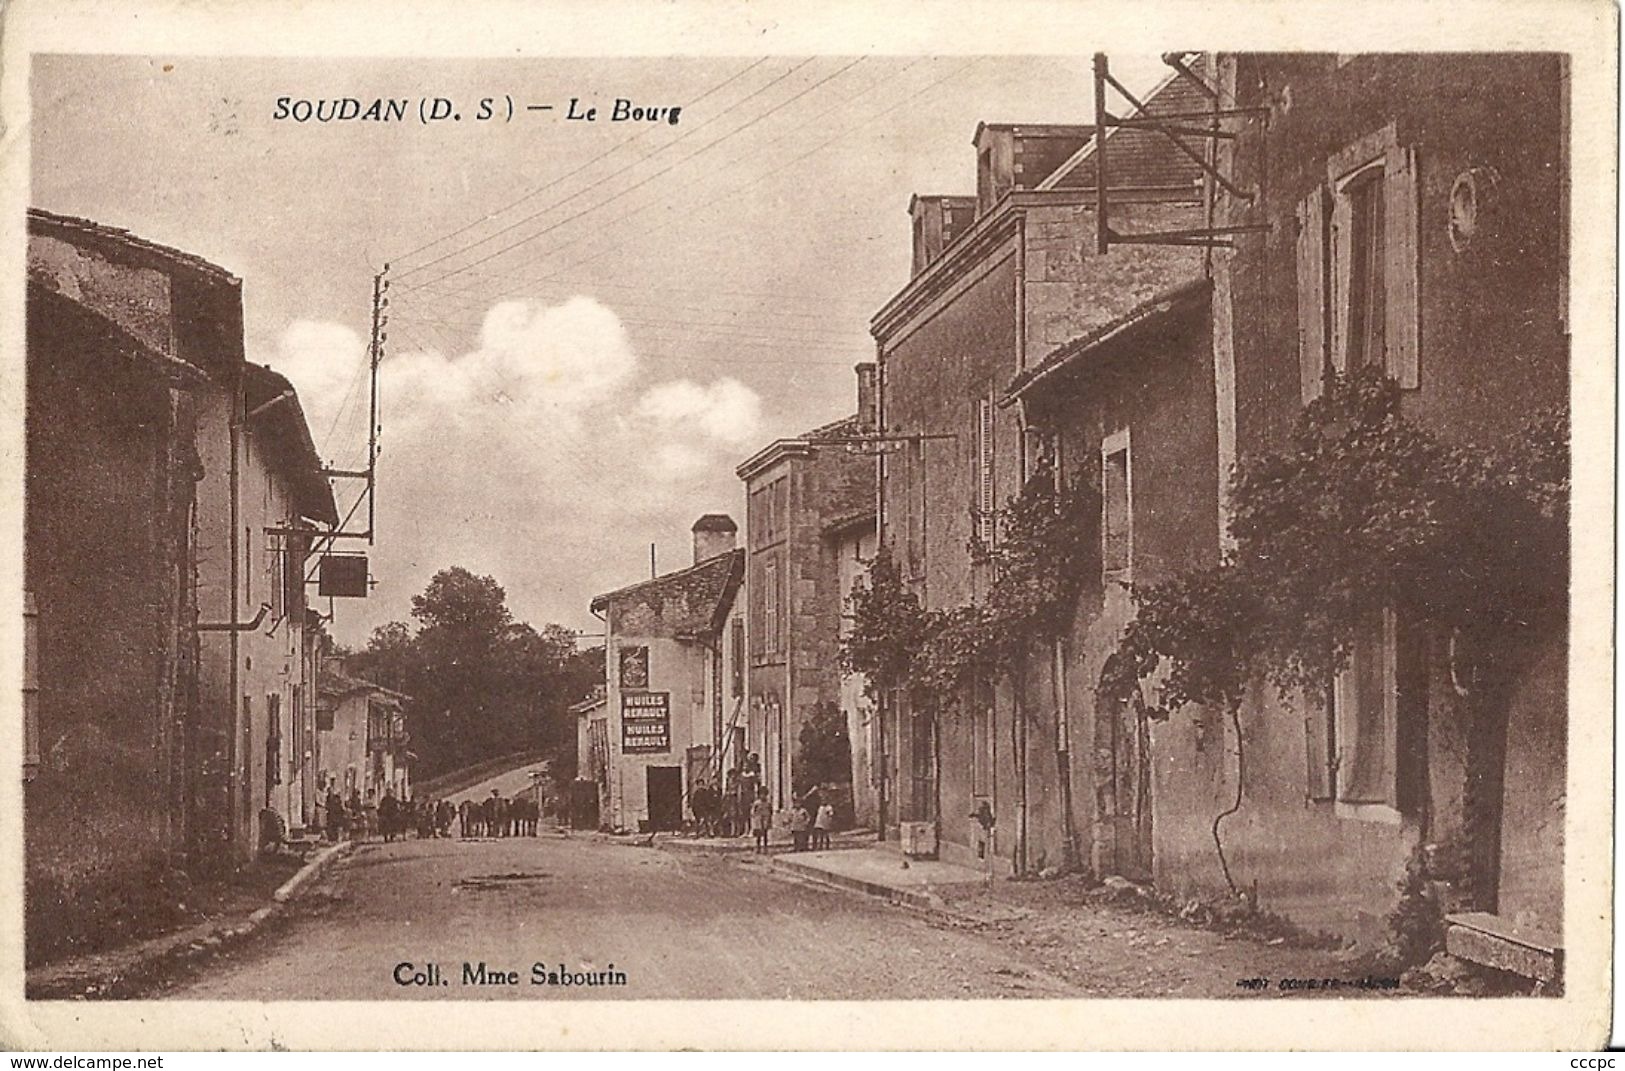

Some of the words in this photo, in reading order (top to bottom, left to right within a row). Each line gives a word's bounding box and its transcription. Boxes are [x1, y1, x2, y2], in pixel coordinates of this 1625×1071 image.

[626, 696, 664, 706] HUILES
[623, 708, 667, 719] RENAULT
[626, 724, 665, 735] HUILES
[624, 736, 667, 747] RENAULT
